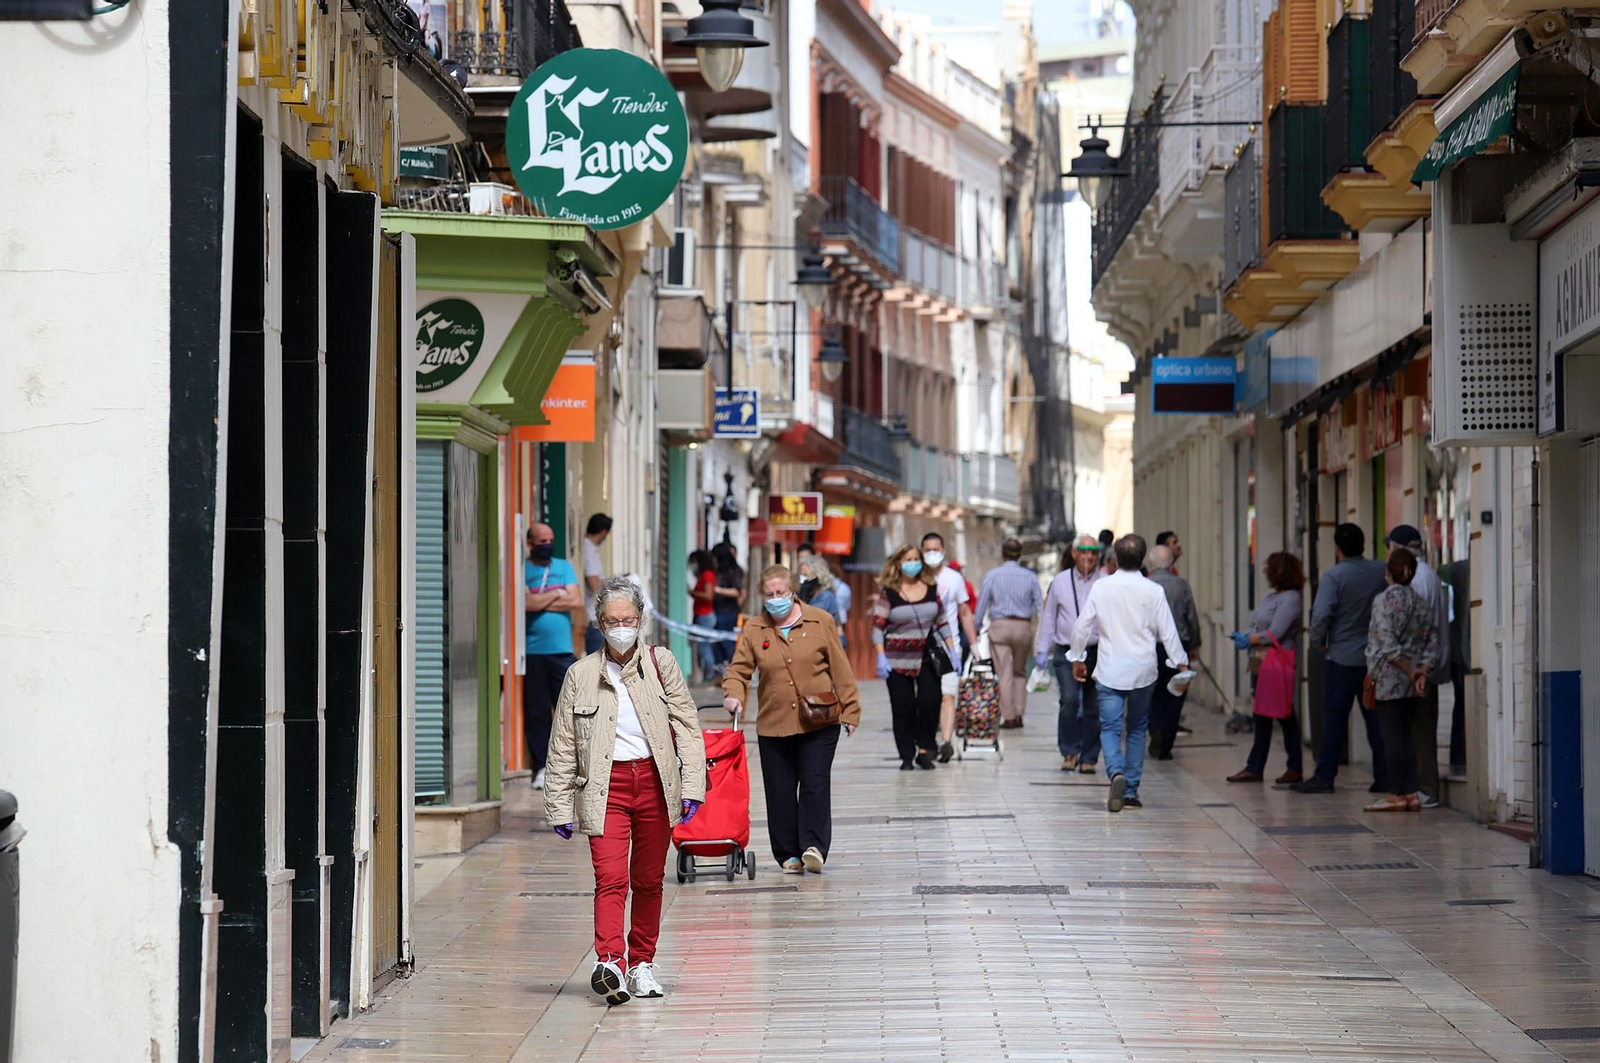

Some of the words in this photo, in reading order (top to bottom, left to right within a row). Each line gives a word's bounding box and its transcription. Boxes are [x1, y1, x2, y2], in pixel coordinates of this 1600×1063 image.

[612, 92, 668, 114] Tiendas
[559, 207, 605, 224] Fundada
[606, 214, 620, 223] en
[620, 203, 643, 220] 1915
[1193, 363, 1233, 377] urbano
